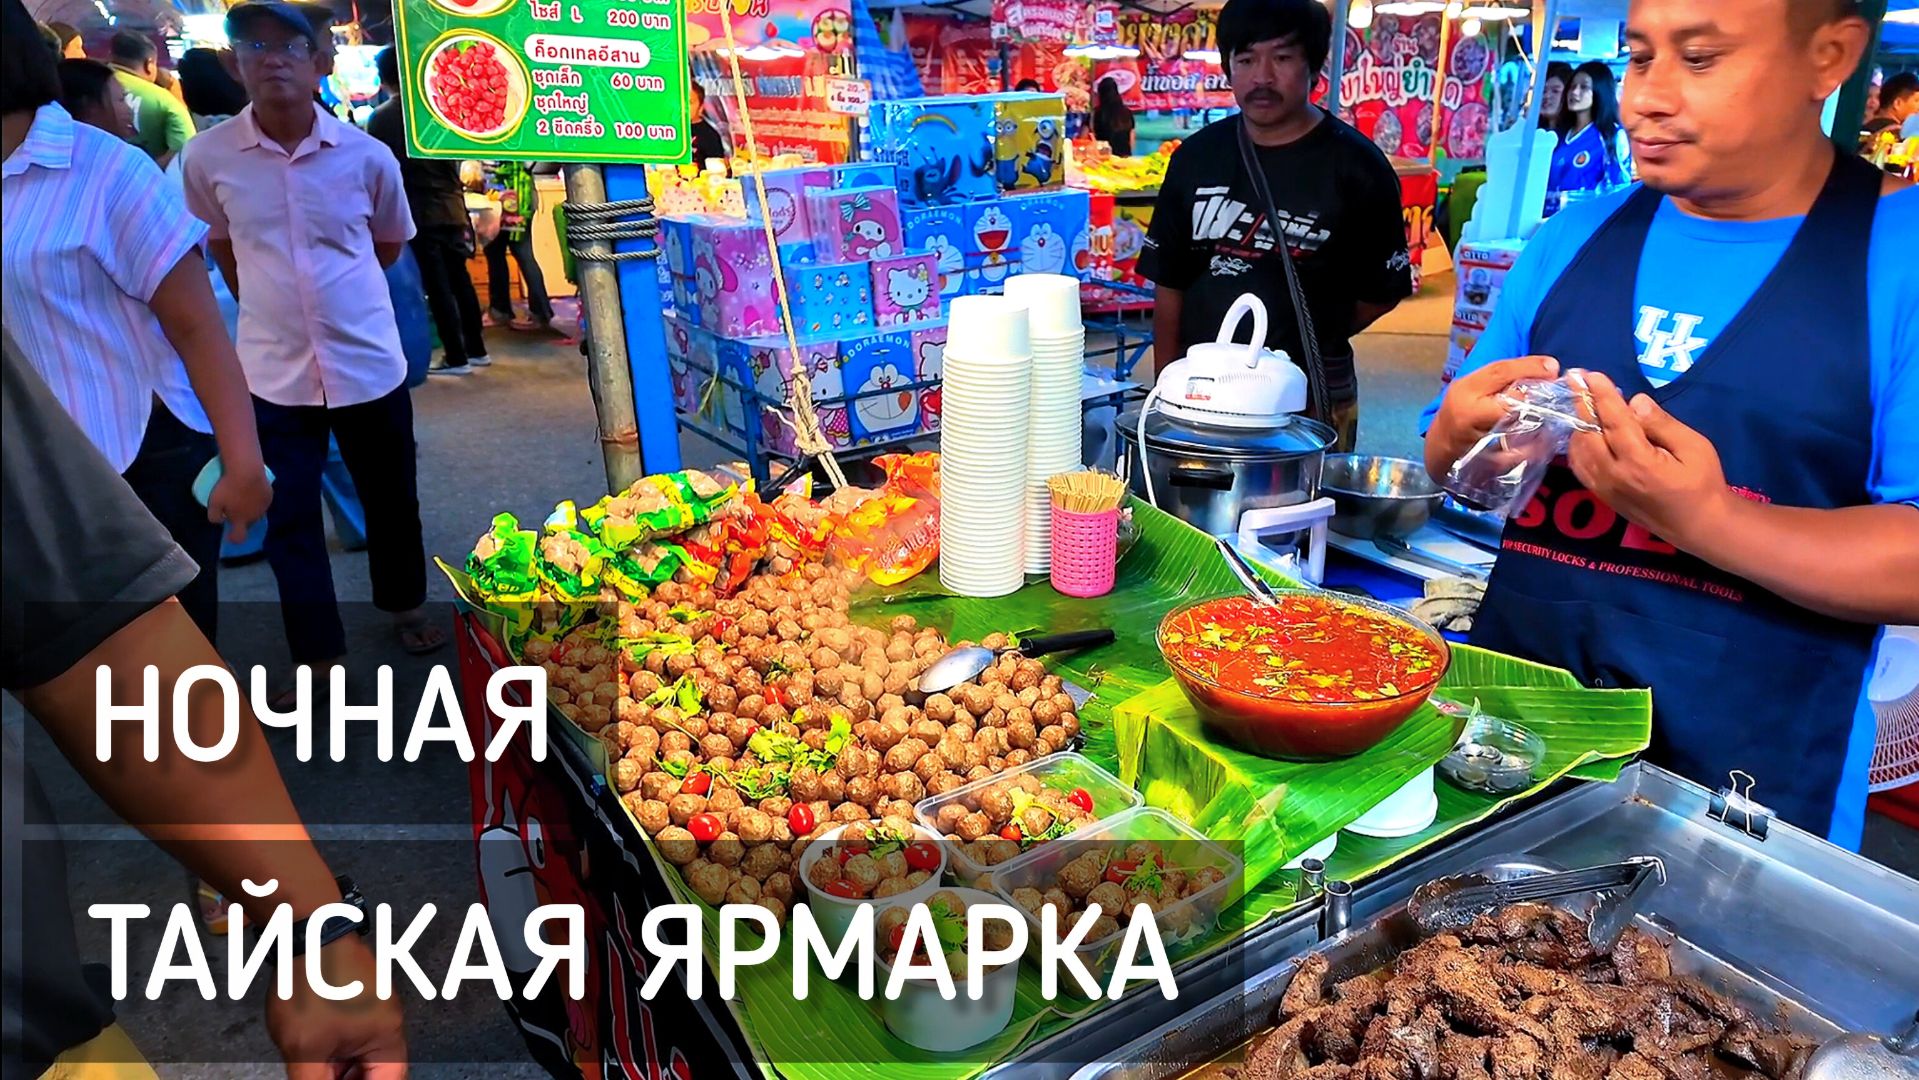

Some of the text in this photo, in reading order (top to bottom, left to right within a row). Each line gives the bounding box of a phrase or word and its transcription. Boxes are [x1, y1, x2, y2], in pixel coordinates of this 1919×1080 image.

[572, 7, 582, 21] L
[608, 10, 638, 26] 200
[643, 14, 670, 28] บาท
[534, 38, 641, 64] ค็อกเทลอีสาน
[534, 67, 664, 90] ชุดเล็ก 60 บาท
[535, 91, 588, 114] ชุดใหญ่
[537, 116, 675, 139] 2 ขีดครึ่ง 100 บาท
[907, 209, 962, 230] DORAEMON
[847, 334, 912, 358] DORAEMON
[1634, 304, 1709, 373] UK
[1513, 541, 1552, 559] SECURITY
[1551, 551, 1587, 568] LOCKS
[1588, 560, 1597, 570] &
[1599, 560, 1698, 590] PROFESSIONAL
[1701, 580, 1743, 603] TOOLS
